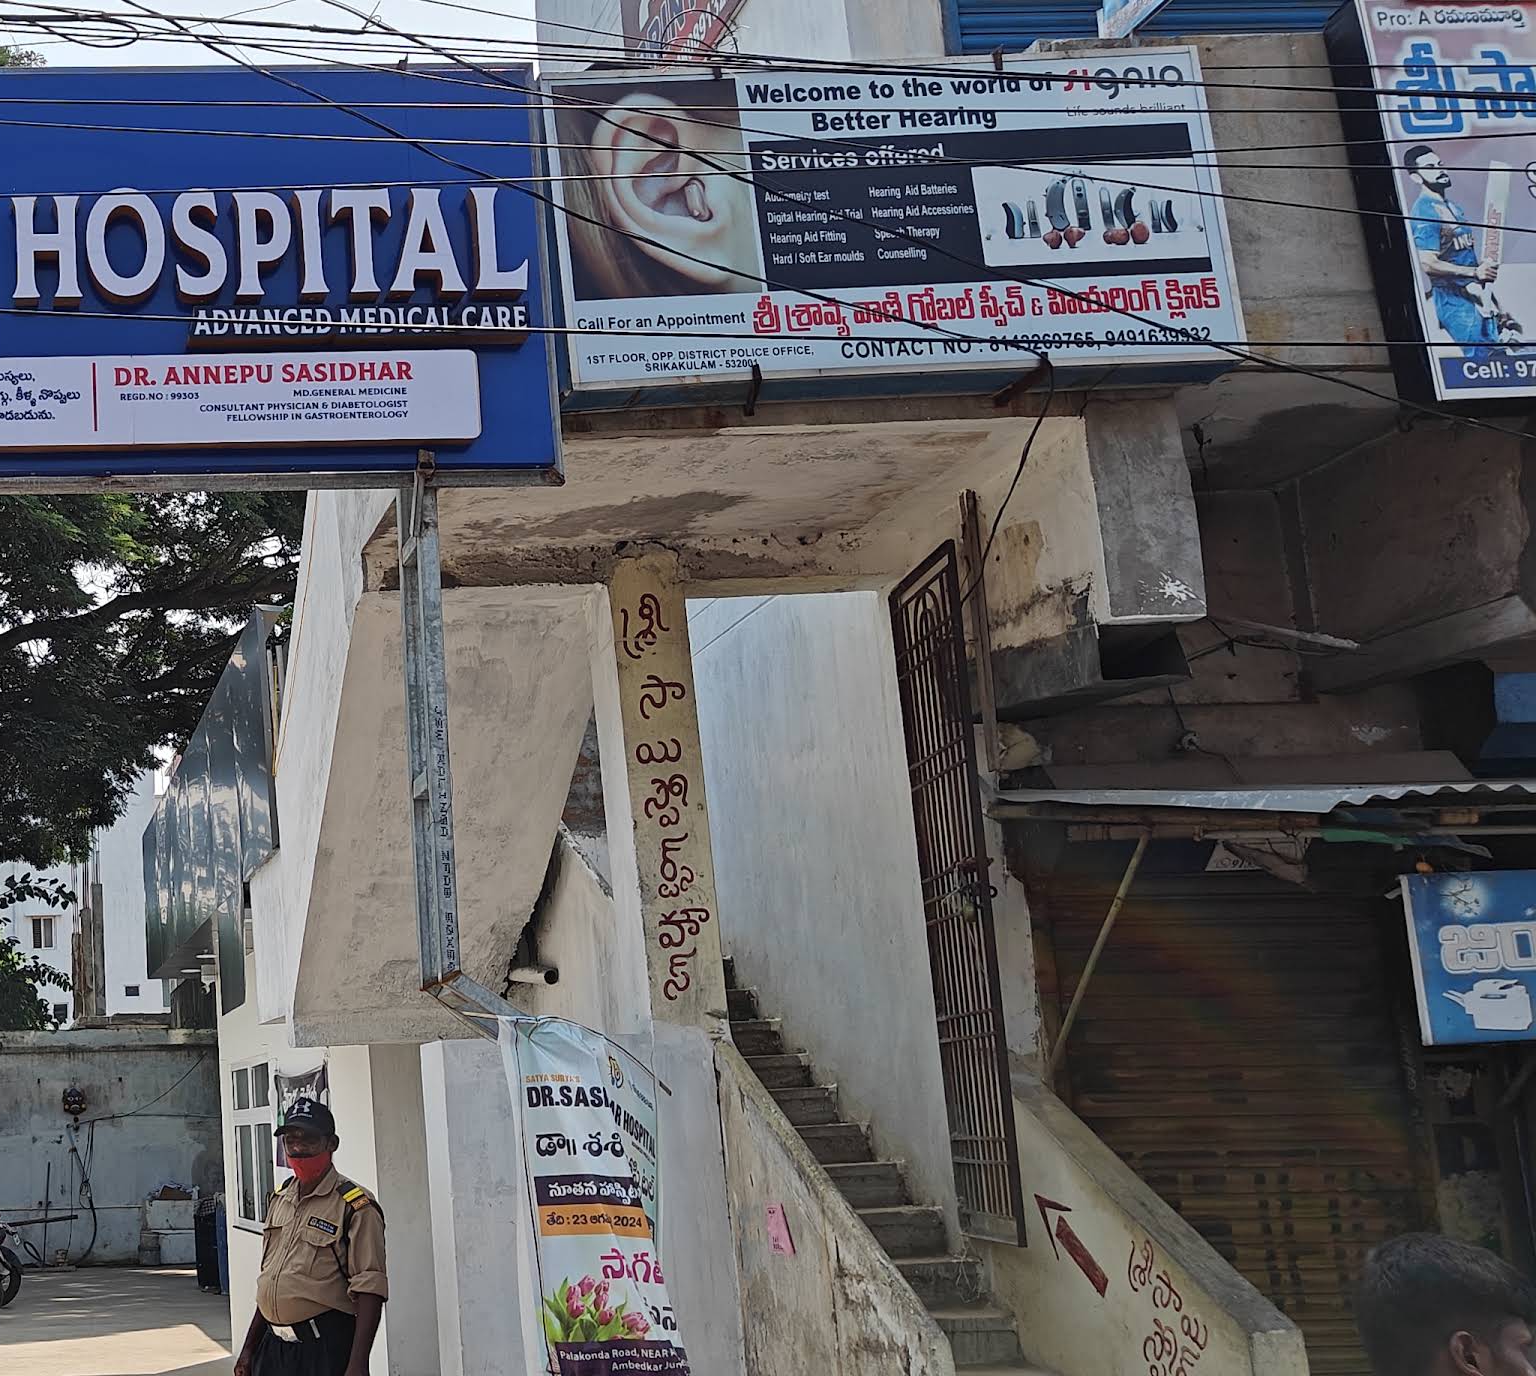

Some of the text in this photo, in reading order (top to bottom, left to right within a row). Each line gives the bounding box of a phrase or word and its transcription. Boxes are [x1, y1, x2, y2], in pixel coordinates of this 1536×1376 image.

[1376, 11, 1413, 26] Pro:
[1418, 10, 1432, 25] A
[745, 71, 1053, 105] Welcome to the world of
[1395, 42, 1464, 135] శ్రీ
[812, 106, 998, 132] Better Hearing
[761, 150, 858, 171] Services
[813, 189, 830, 201] test
[868, 184, 958, 200] Hearing Aid Batteries
[767, 211, 794, 225] Digital
[795, 210, 828, 224] Hearing
[871, 206, 904, 220] Hearing
[905, 205, 921, 217] Aid
[770, 230, 847, 246] Hearing Aid Fitting
[906, 226, 940, 240] Therapy
[10, 185, 530, 298] HOSPITAL
[772, 253, 794, 265] Hard
[799, 252, 817, 264] Soft
[817, 252, 833, 263] Ear
[833, 251, 865, 263] moulds
[877, 247, 927, 261] Counselling
[752, 295, 781, 334] శ్రీ
[1031, 297, 1043, 316] &
[1165, 277, 1221, 319] క్లినిక్
[193, 305, 528, 337] ADVANCED MEDICAL CARE
[577, 311, 746, 331] Call For an Appointment
[586, 354, 607, 366] 1ST
[609, 352, 649, 364] FLOOR,
[678, 348, 727, 361] DISTRICT
[730, 347, 769, 359] POLICE
[772, 345, 815, 358] OFFICE,
[840, 340, 935, 360] CONTACT
[943, 338, 972, 355] NO
[113, 361, 413, 387] DR. ANNEPU SASIDHAR
[644, 360, 717, 372] SRIKAKULAM
[1462, 357, 1536, 380] Cell: 97
[170, 391, 200, 400] 99303
[293, 387, 408, 397] MD.GENERAL MEDICINE
[199, 399, 408, 412] CONSULTANT PHYSICIAN & DIABETOLOGIST
[226, 410, 408, 422] FELLOWSHIP IN GASTROENTEROLOGY
[620, 592, 671, 660] శ్రీ
[525, 1073, 549, 1084] SATYA
[623, 1112, 657, 1159] HOSPITAL
[547, 1180, 598, 1199] నూతన
[572, 1214, 588, 1225] 23
[613, 1215, 643, 1229] 2024
[560, 1349, 610, 1362] Palakonda
[611, 1348, 640, 1359] Road,
[641, 1348, 669, 1360] NEAR
[611, 1360, 663, 1372] Ambedkar
